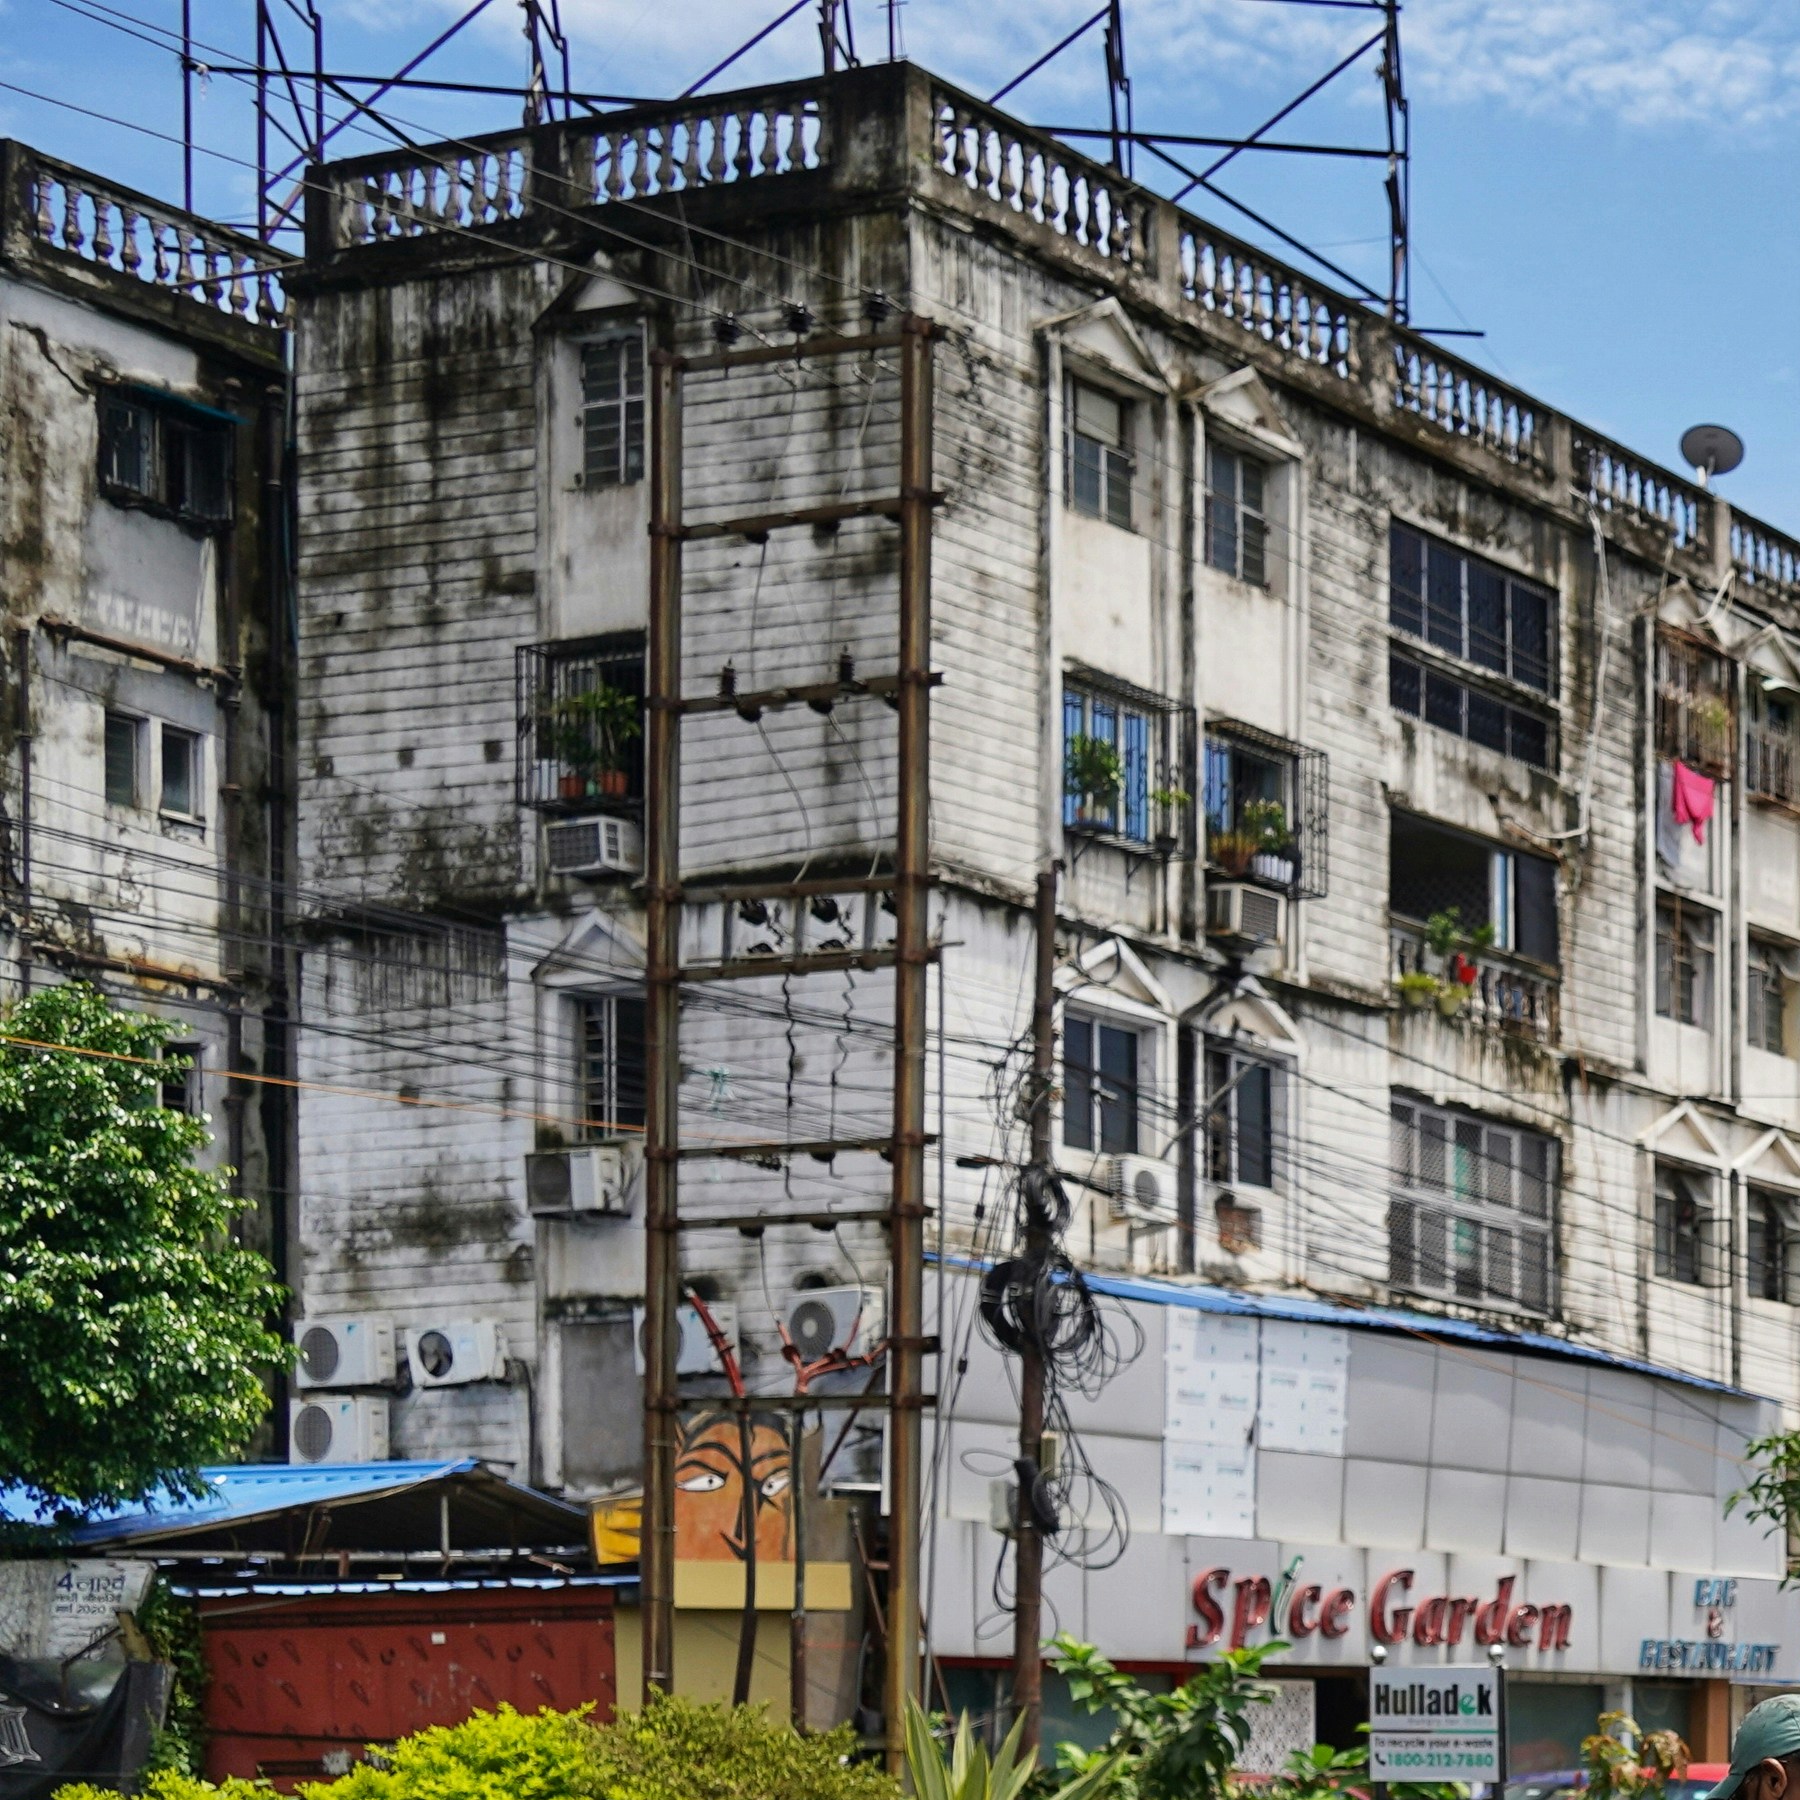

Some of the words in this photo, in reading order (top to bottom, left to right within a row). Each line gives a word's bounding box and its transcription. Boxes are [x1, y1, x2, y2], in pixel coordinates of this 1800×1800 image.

[1186, 1555, 1355, 1651] Spice
[1370, 1569, 1573, 1652] Garden
[1694, 1577, 1739, 1608] BAR
[1638, 1638, 1781, 1673] RESTAURANT
[1375, 1683, 1493, 1716] Hulladek
